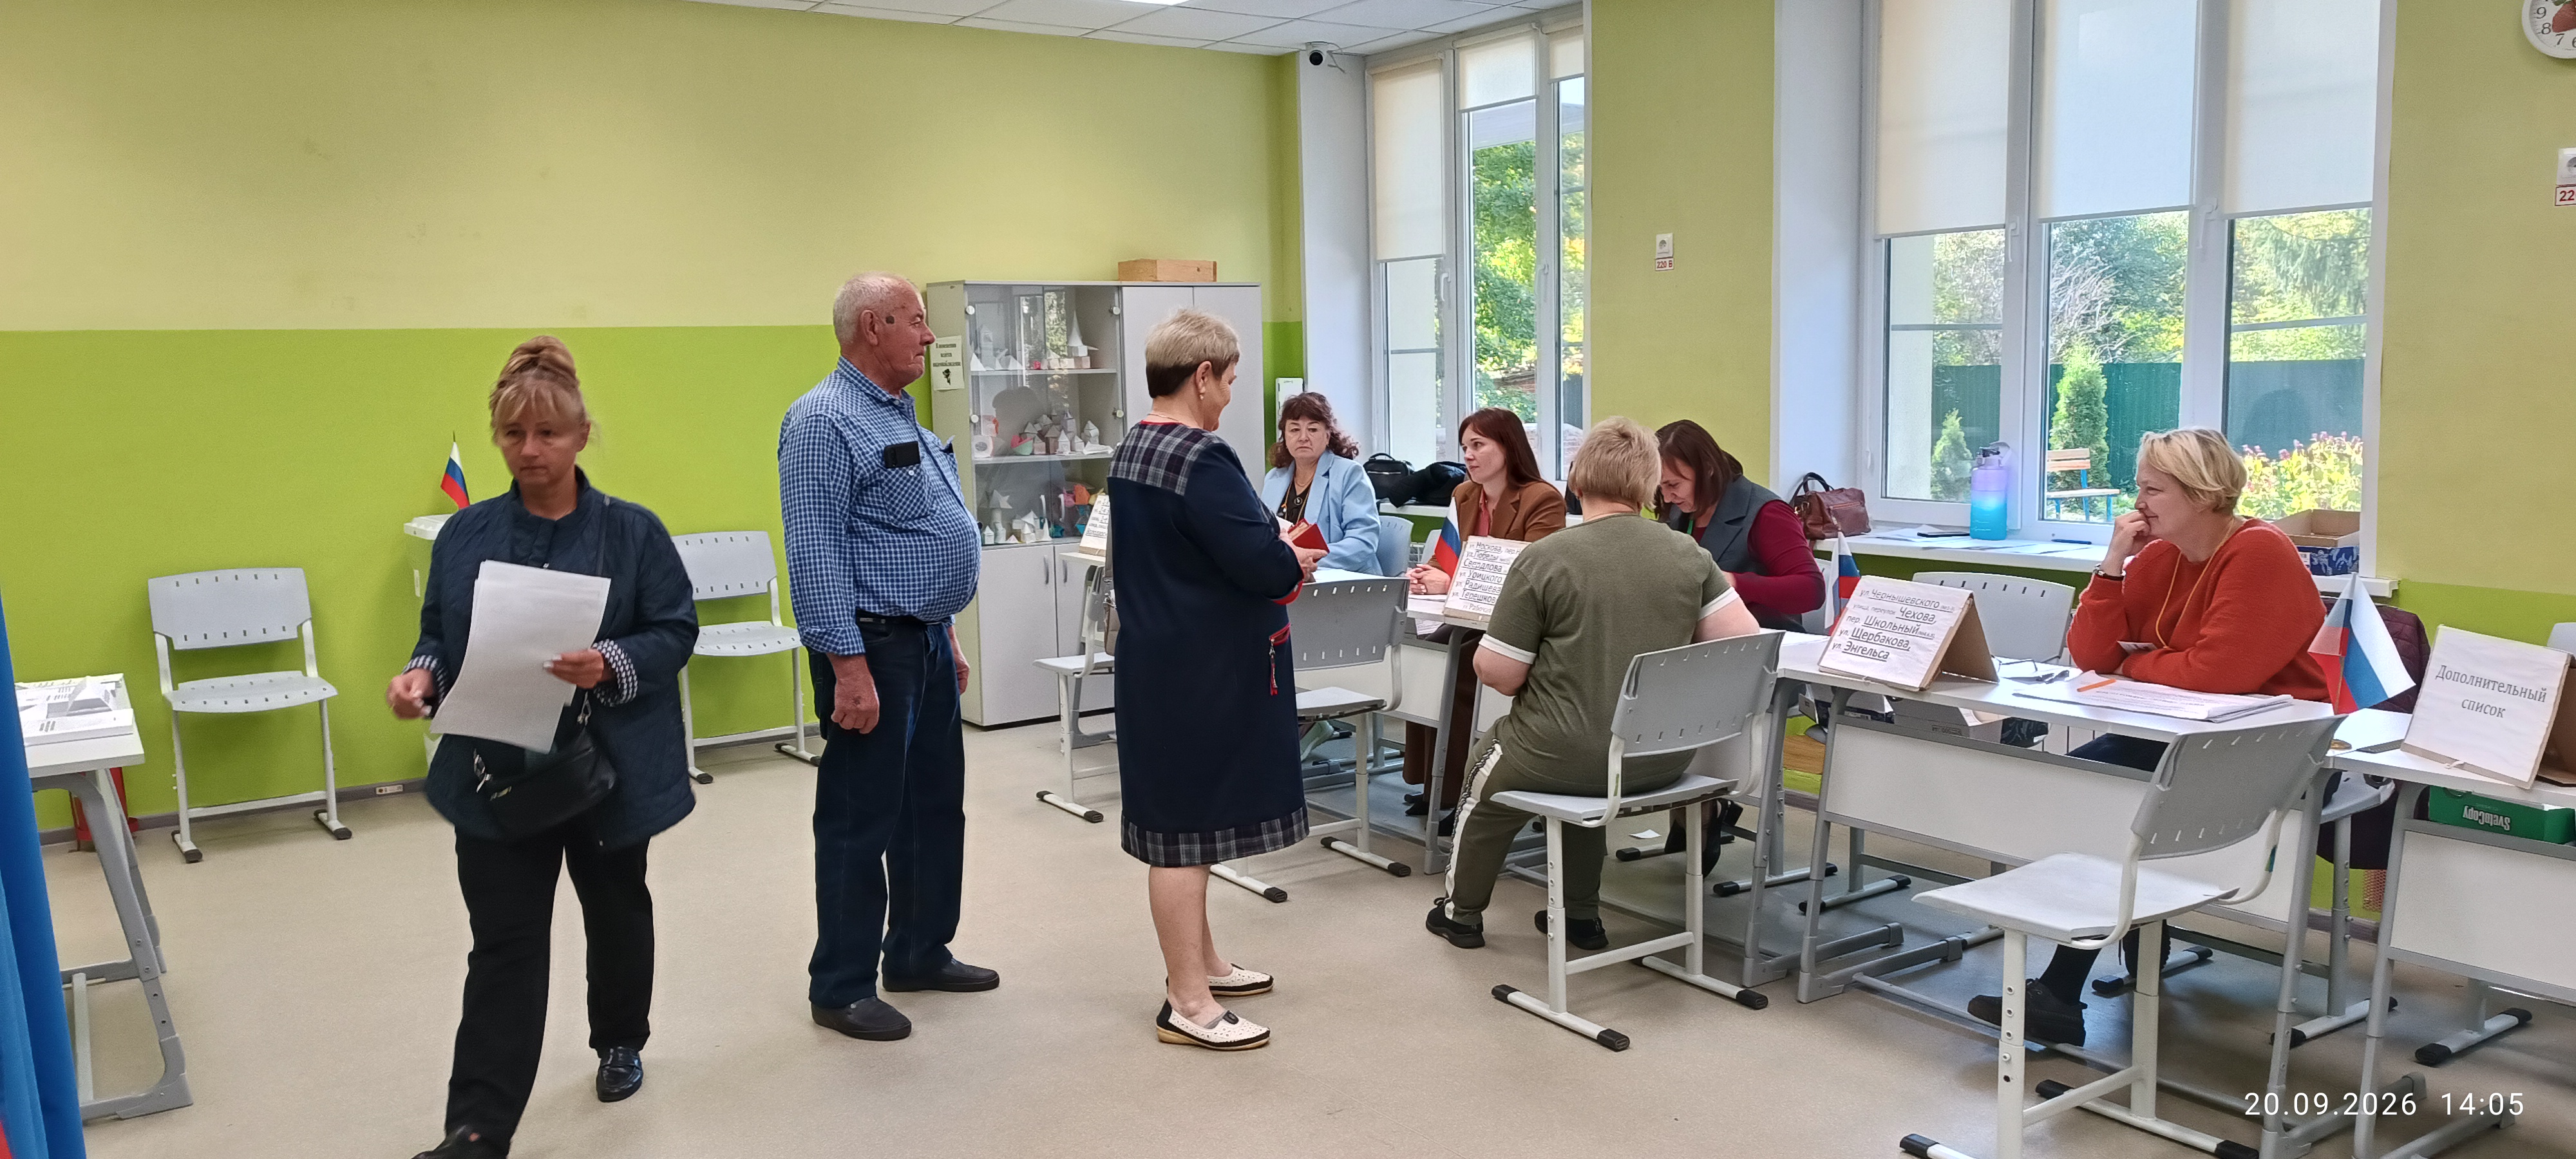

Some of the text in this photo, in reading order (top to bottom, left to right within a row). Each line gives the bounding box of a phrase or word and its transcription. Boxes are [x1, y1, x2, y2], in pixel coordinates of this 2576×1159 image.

[2537, 7, 2546, 19] 9
[2542, 23, 2551, 34] 8
[2555, 33, 2564, 45] 7
[2559, 190, 2576, 202] 22
[1464, 558, 1502, 572] Свердлова
[1468, 569, 1502, 583] Урицкого
[1462, 590, 1496, 603] Терешков
[1871, 589, 1940, 608] Чернышевского
[1900, 607, 1937, 623] Чехова,
[1846, 615, 1861, 624] пер.
[1864, 615, 1921, 634] Школьный
[1852, 627, 1911, 650] Щербакова,
[1832, 641, 1889, 659] ул. Энгельса
[2435, 664, 2547, 703] Дополнительный
[2461, 699, 2506, 719] список
[2463, 806, 2510, 831] SvetoCopy
